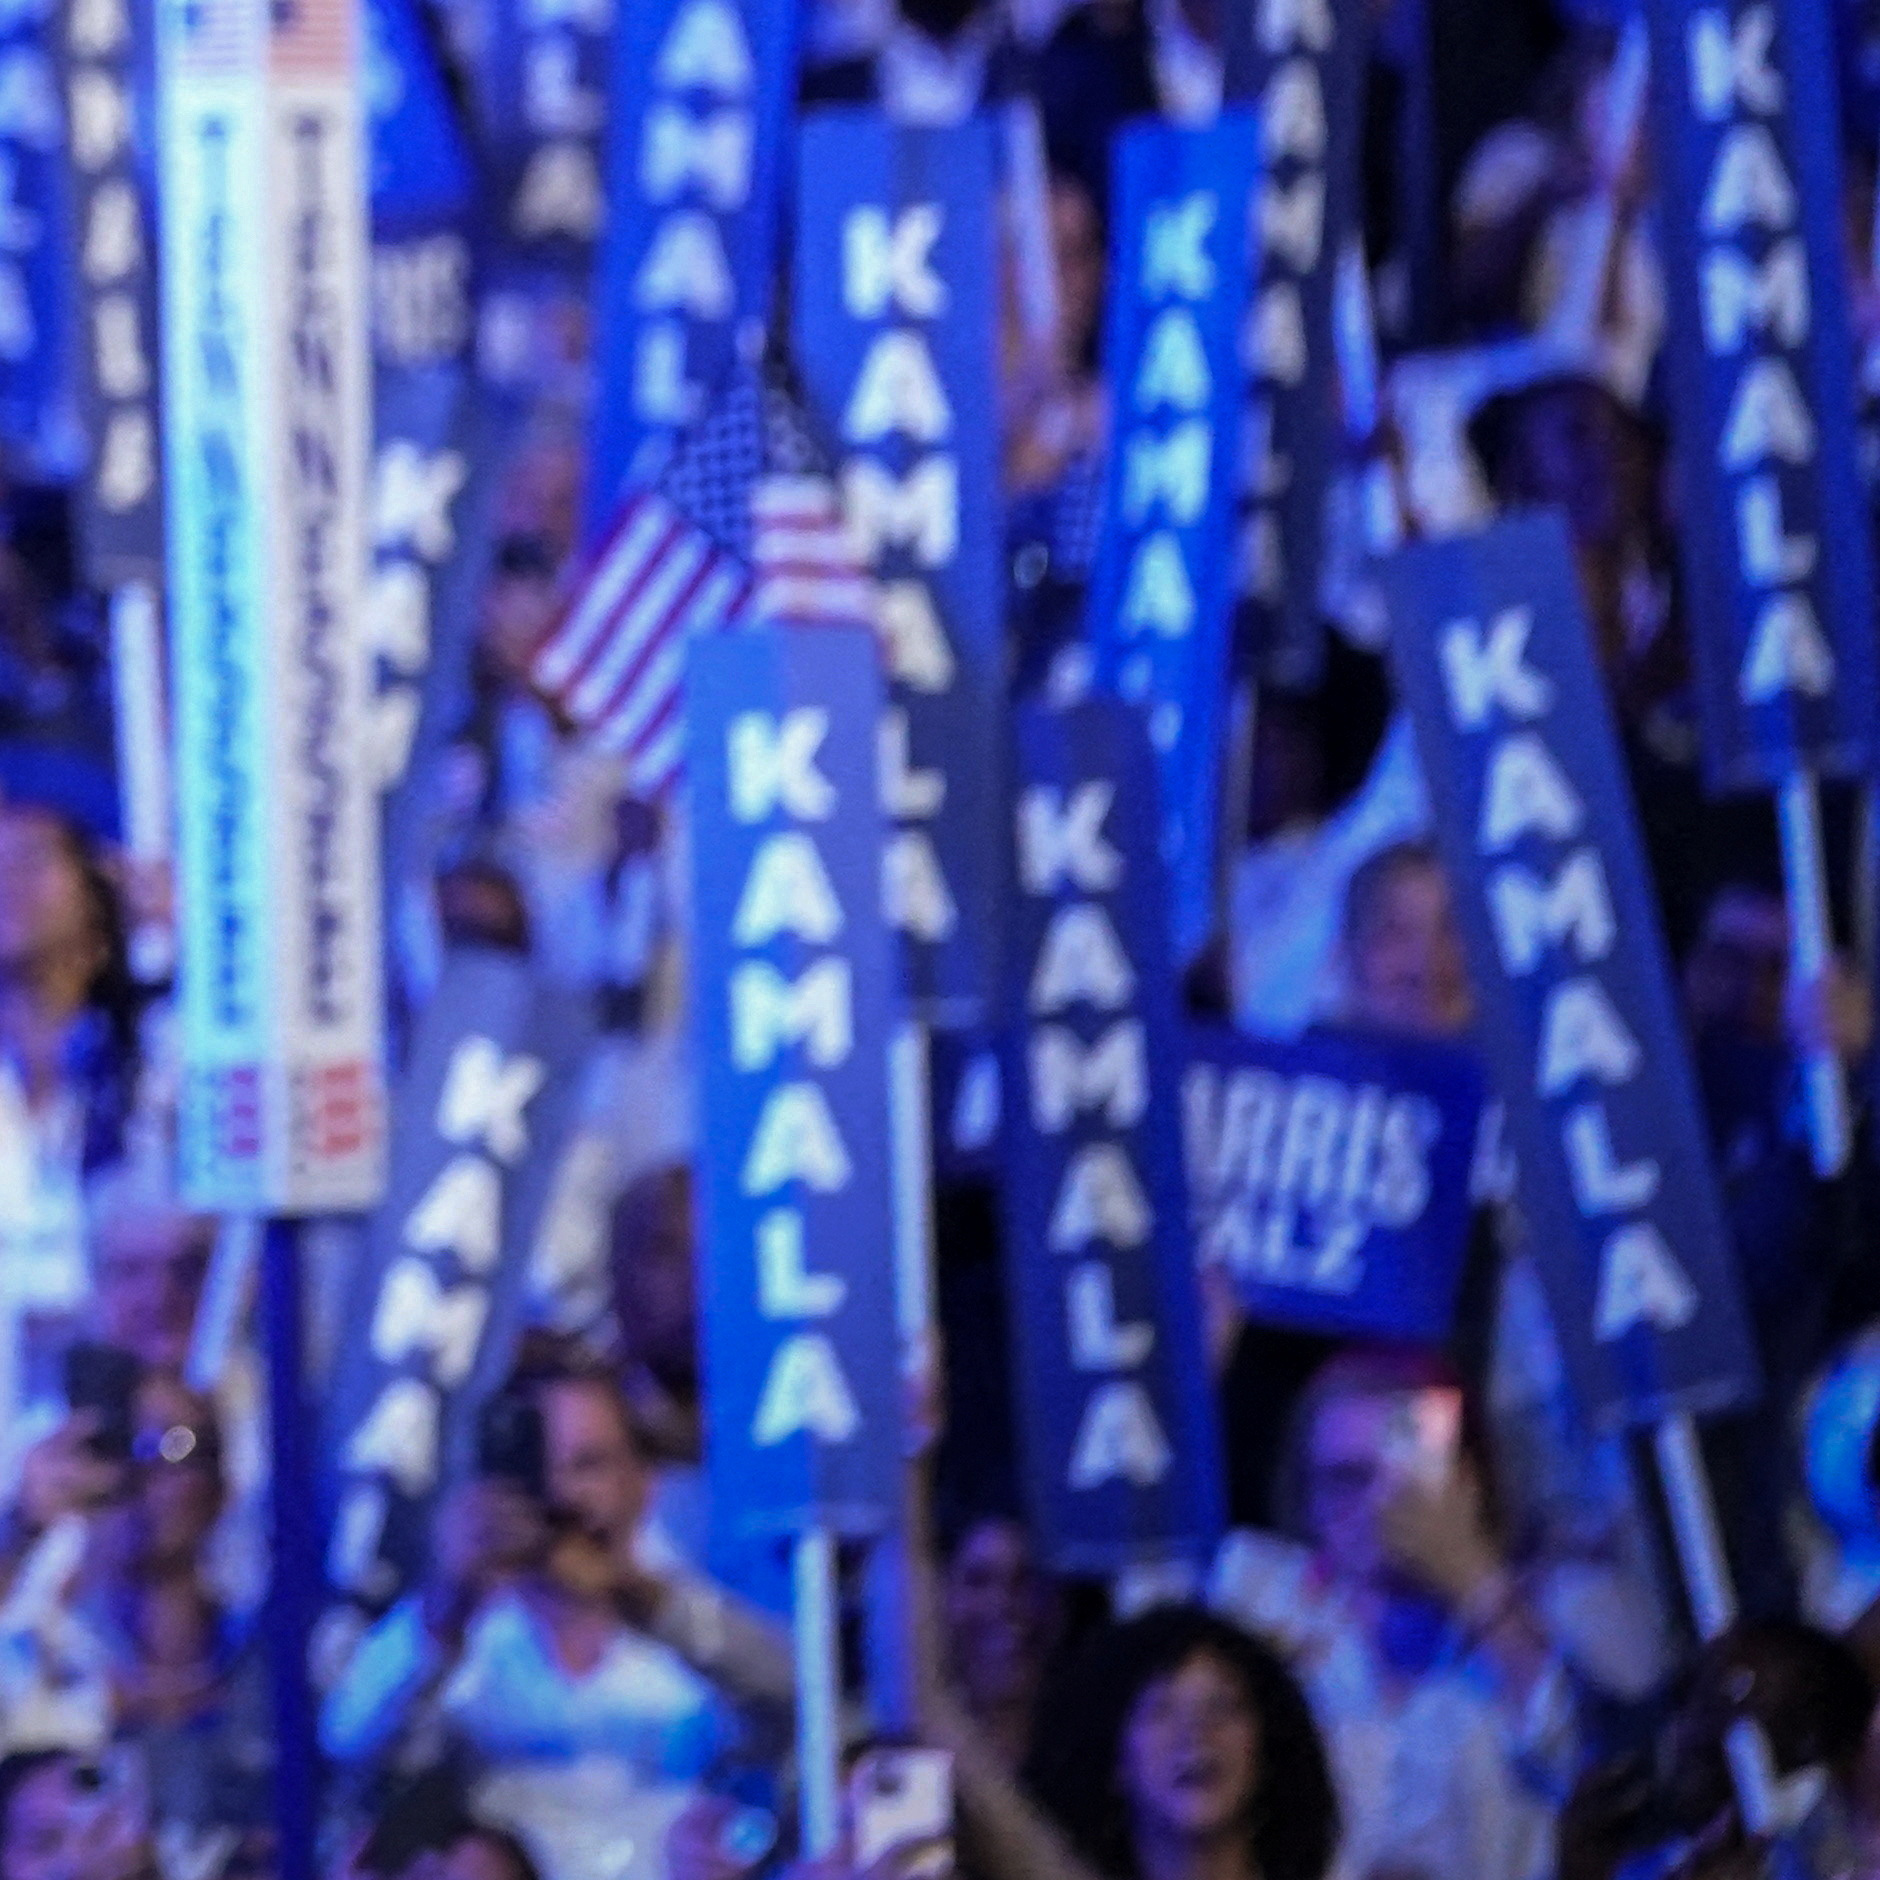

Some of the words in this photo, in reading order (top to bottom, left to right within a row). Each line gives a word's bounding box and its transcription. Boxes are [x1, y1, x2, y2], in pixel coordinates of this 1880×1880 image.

[1688, 3, 1842, 702] KAMALA
[325, 1032, 546, 1602] KAMAL
[728, 708, 862, 1447] KAMALA
[1013, 778, 1177, 1497] KAMALA
[1180, 1060, 1442, 1230] RRIS
[1195, 1200, 1370, 1298] ALZ
[1438, 603, 1702, 1347] KAMALA
